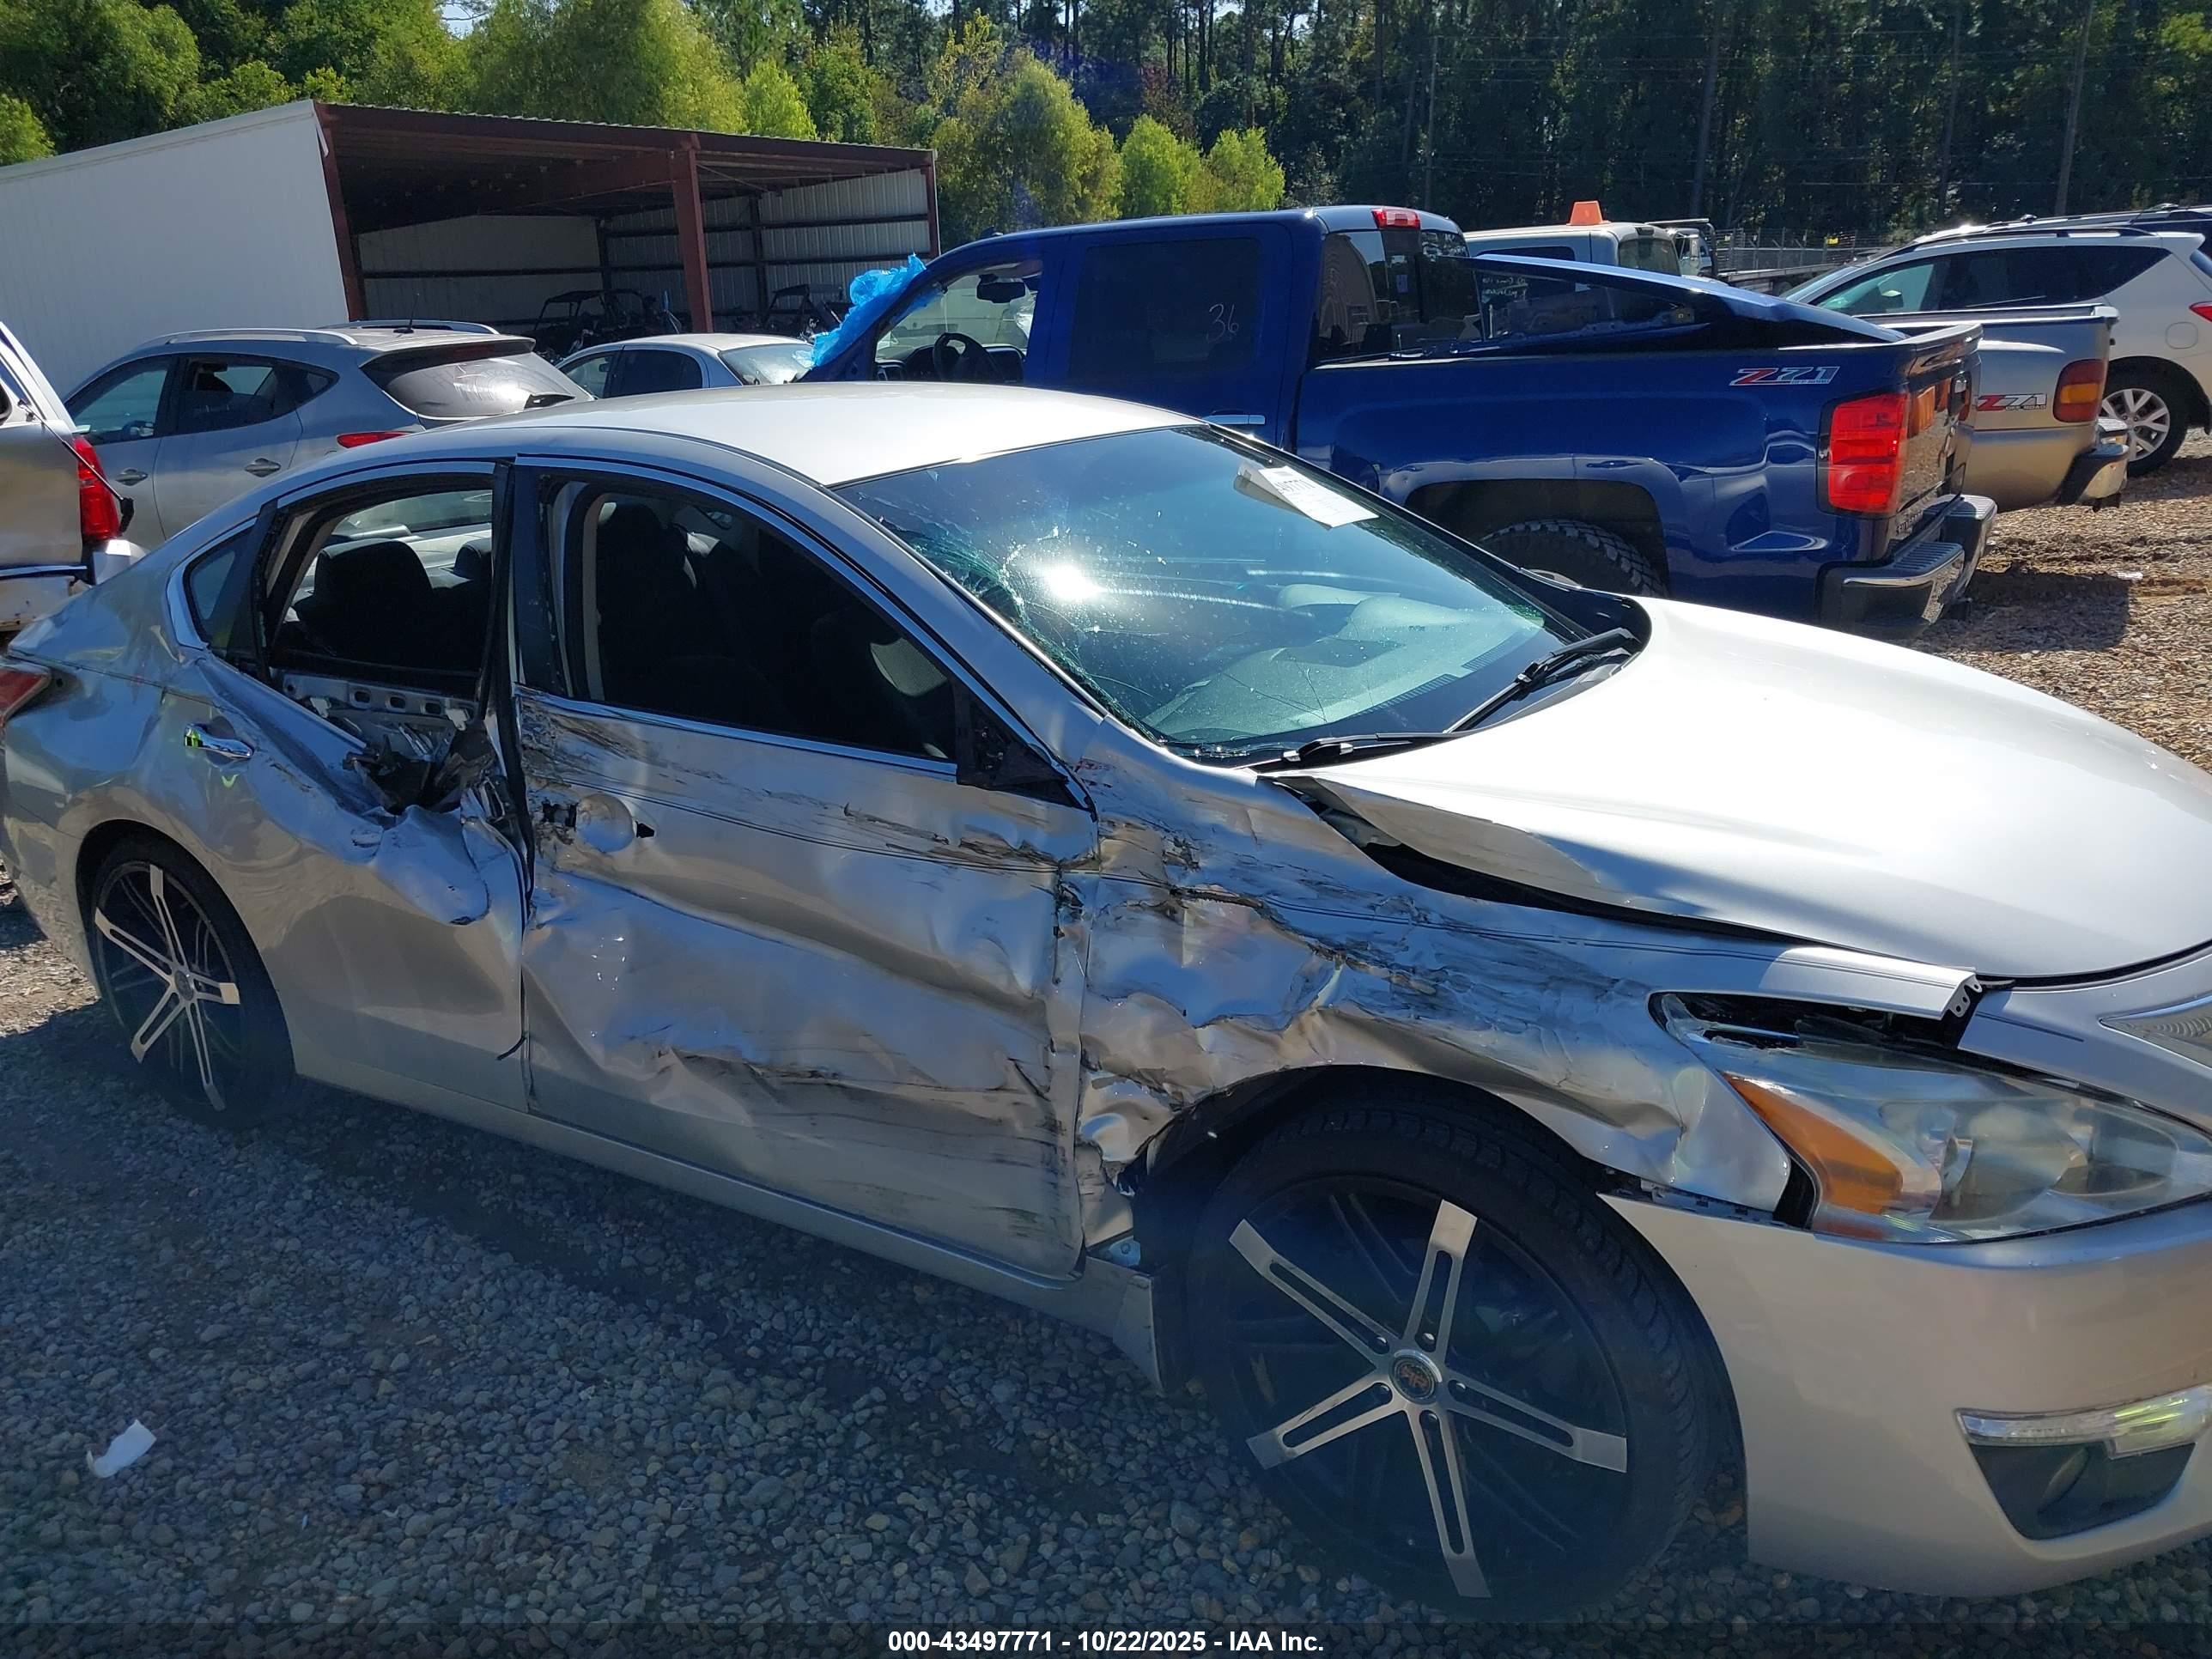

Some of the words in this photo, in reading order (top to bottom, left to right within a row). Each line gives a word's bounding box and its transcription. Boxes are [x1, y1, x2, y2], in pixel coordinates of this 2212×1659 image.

[1207, 303, 1239, 343] 36
[1729, 366, 1840, 386] Z71
[1977, 392, 2047, 411] Z71
